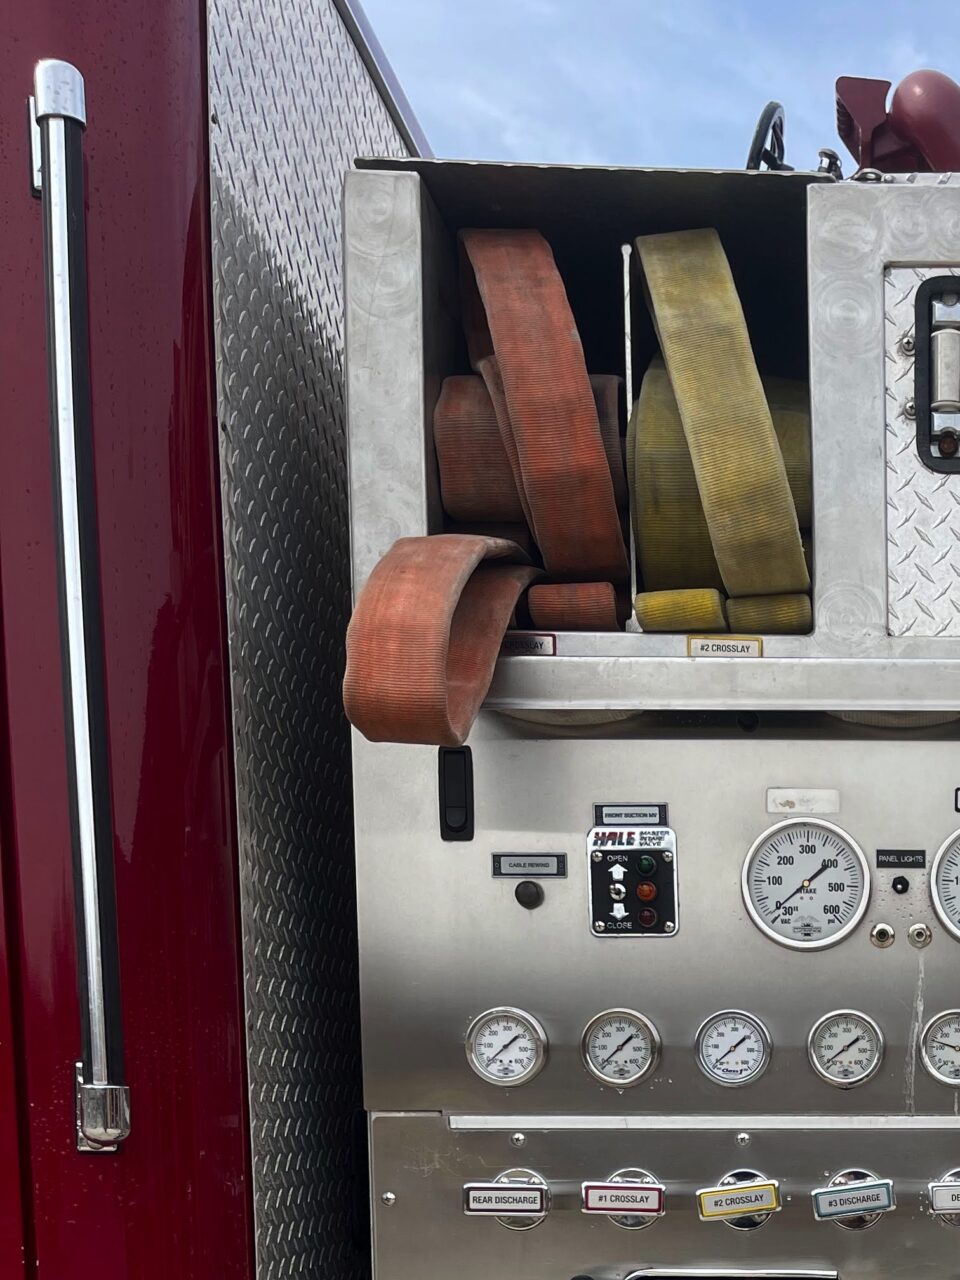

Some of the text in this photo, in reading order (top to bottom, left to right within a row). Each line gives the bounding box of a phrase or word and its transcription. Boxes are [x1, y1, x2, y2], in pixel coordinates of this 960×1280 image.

[700, 644, 750, 653] #2 CROSSLAY
[593, 832, 636, 846] HALE
[798, 844, 816, 854] 300
[777, 856, 794, 866] 200
[821, 859, 838, 868] 400
[766, 876, 782, 886] 100
[828, 883, 845, 892] 500
[823, 905, 840, 914] 600
[472, 1196, 538, 1204] REAR DISCHARGE
[609, 1195, 650, 1203] CROSSLAY
[714, 1194, 764, 1207] #2 CROSSLAY
[828, 1194, 881, 1207] #3 DISCHARGE
